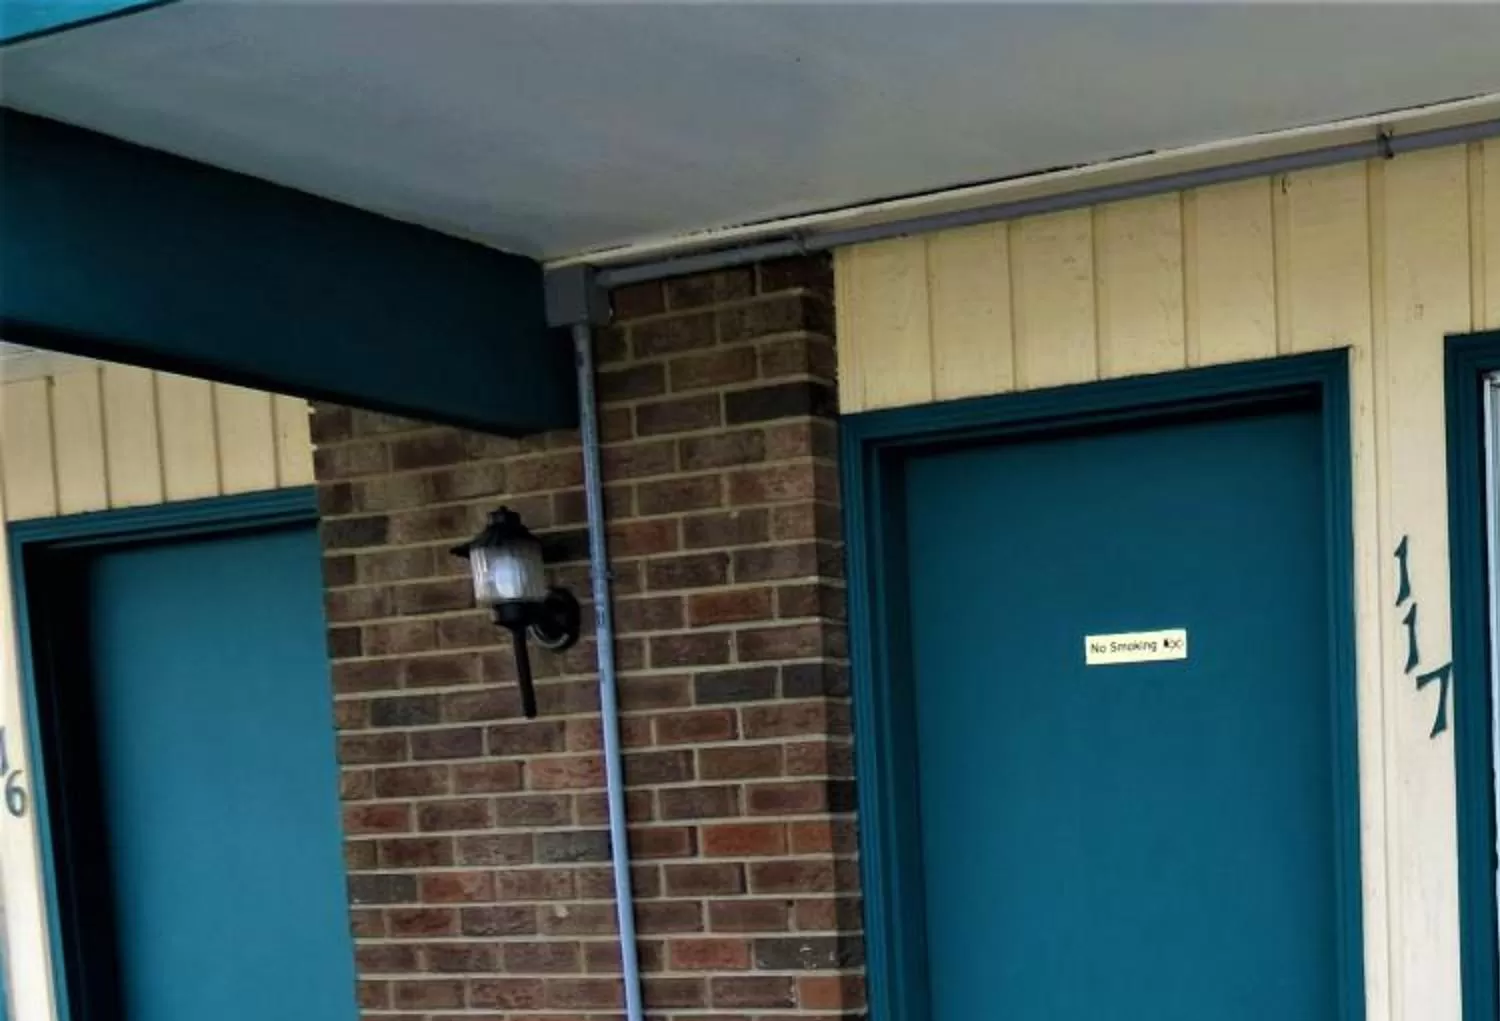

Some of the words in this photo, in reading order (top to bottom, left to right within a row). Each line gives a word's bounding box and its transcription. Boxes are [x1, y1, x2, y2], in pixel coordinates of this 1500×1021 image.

[1090, 642, 1107, 654] No
[1110, 640, 1158, 653] Smoking
[1394, 534, 1453, 739] 117
